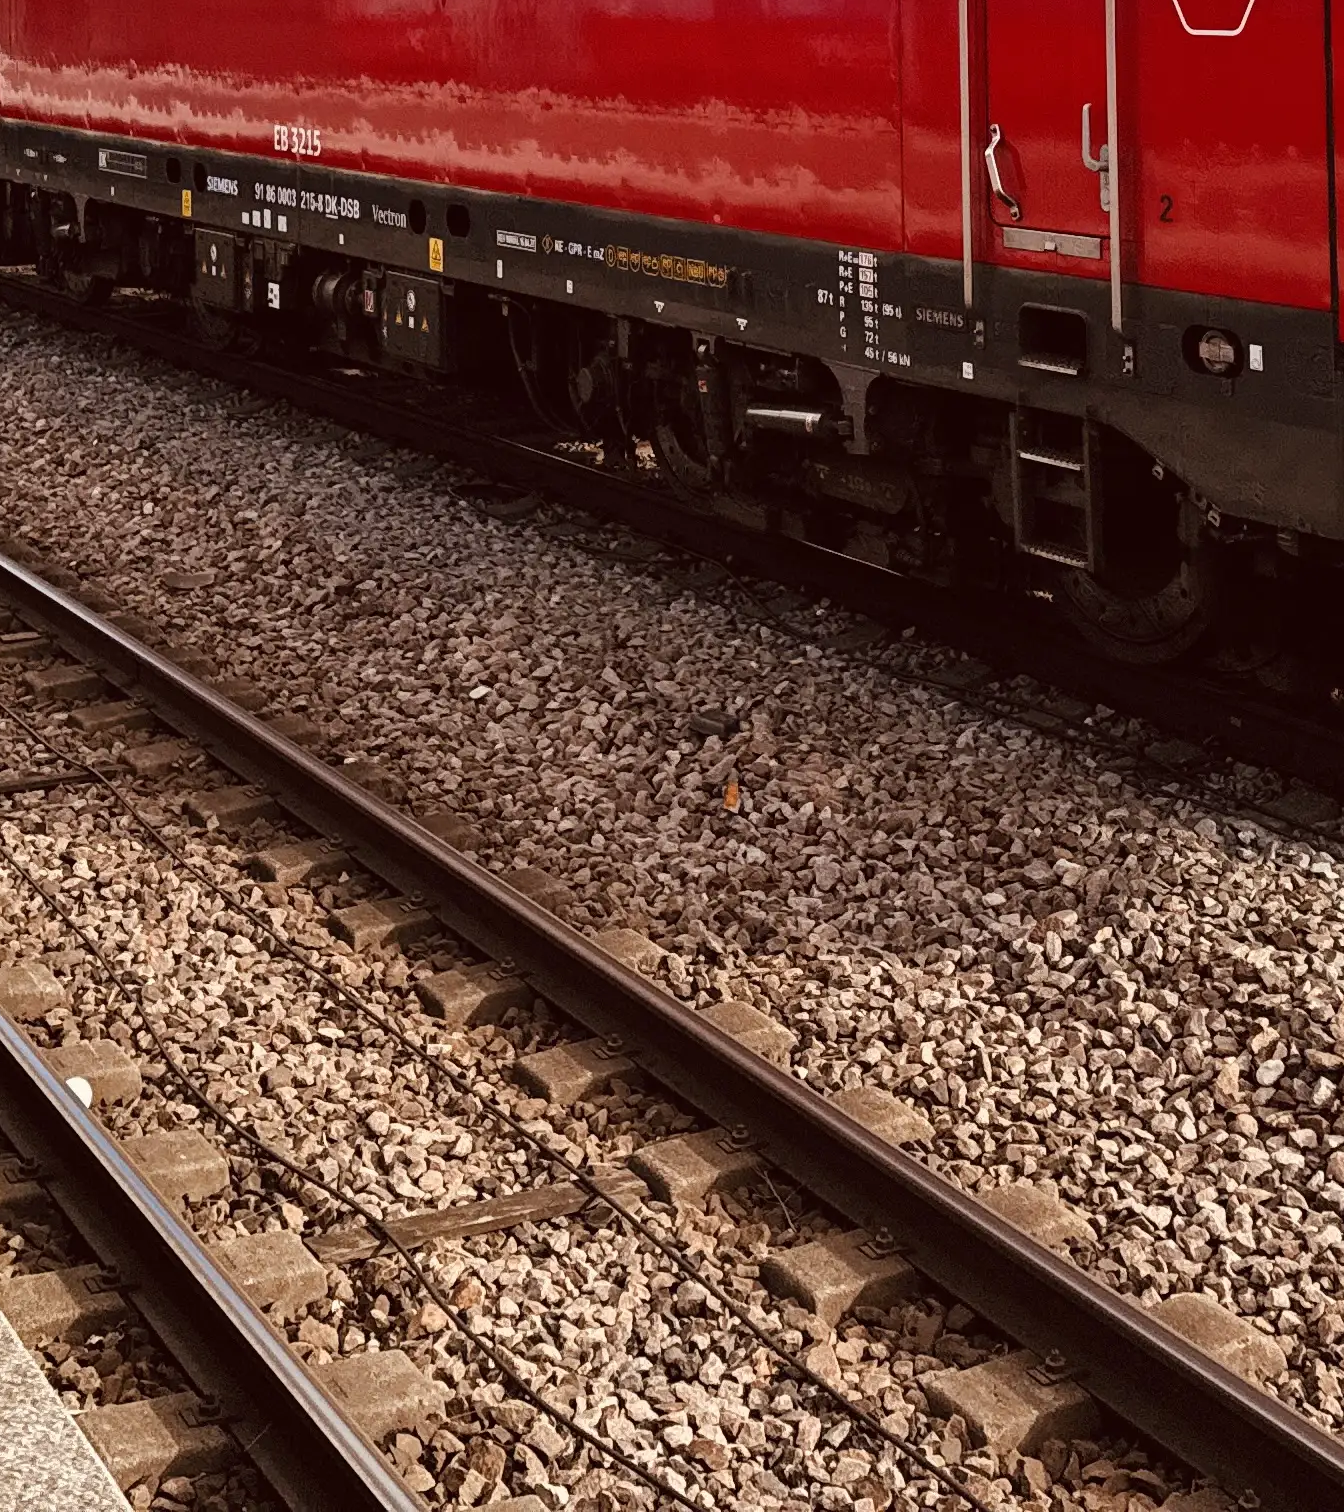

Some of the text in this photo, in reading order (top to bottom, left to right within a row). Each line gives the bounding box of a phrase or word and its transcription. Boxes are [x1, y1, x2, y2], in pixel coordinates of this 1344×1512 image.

[273, 124, 321, 157] EB 3215
[206, 175, 239, 196] SIEMENS
[254, 182, 264, 200] 91
[325, 194, 360, 219] DK-DSB
[1160, 194, 1173, 223] 2
[371, 203, 407, 229] Vectron
[817, 288, 834, 306] 87 t
[839, 295, 845, 308] R
[839, 310, 845, 323] P
[916, 307, 965, 328] SIEMENS
[839, 326, 847, 338] G
[864, 330, 874, 344] 72
